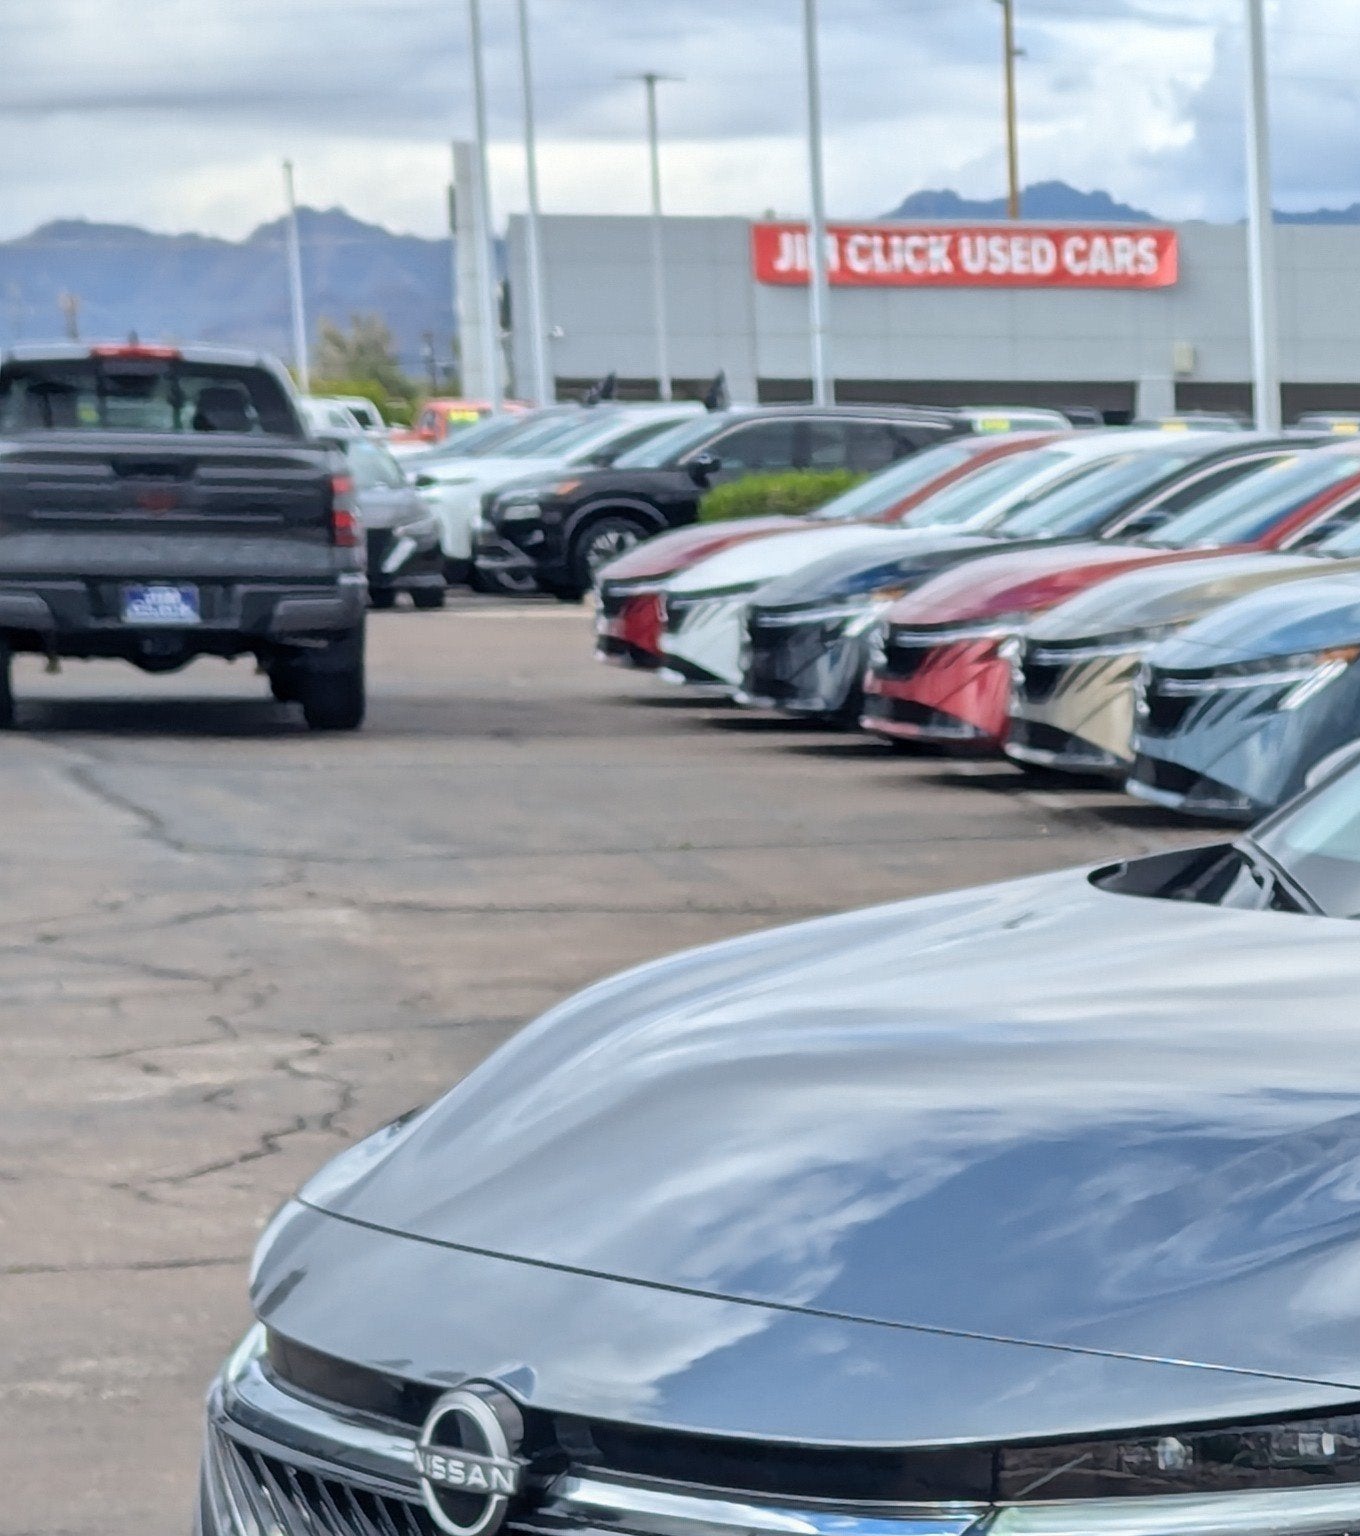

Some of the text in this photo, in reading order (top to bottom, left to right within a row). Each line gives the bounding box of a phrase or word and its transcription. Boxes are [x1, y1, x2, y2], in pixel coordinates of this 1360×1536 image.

[846, 233, 955, 273] CLICK
[959, 235, 1056, 275] USED
[1063, 236, 1158, 275] CARS
[414, 1449, 515, 1494] NISSAN
